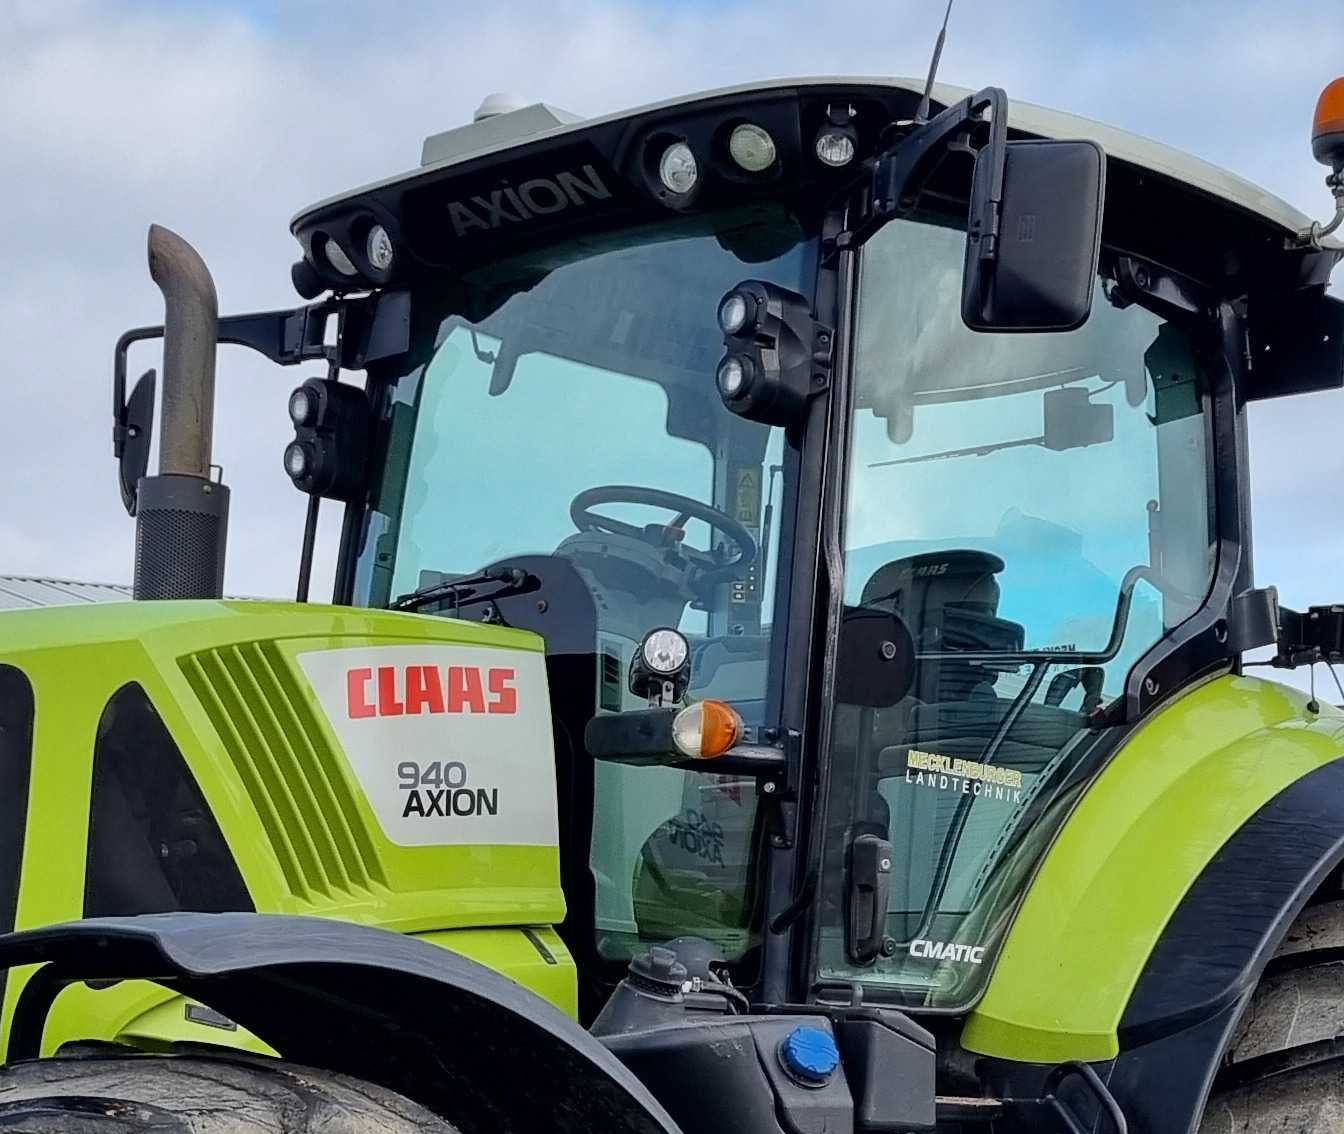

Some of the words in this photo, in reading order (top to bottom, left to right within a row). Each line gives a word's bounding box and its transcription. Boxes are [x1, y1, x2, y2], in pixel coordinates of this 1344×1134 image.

[447, 164, 613, 237] AXION
[346, 664, 517, 719] CLAAS
[397, 761, 467, 789] 940
[907, 749, 1023, 788] MECKLENBURGER
[402, 788, 498, 817] AXION
[906, 769, 1022, 803] LANDTECHNIK
[909, 939, 985, 963] CMATIC
